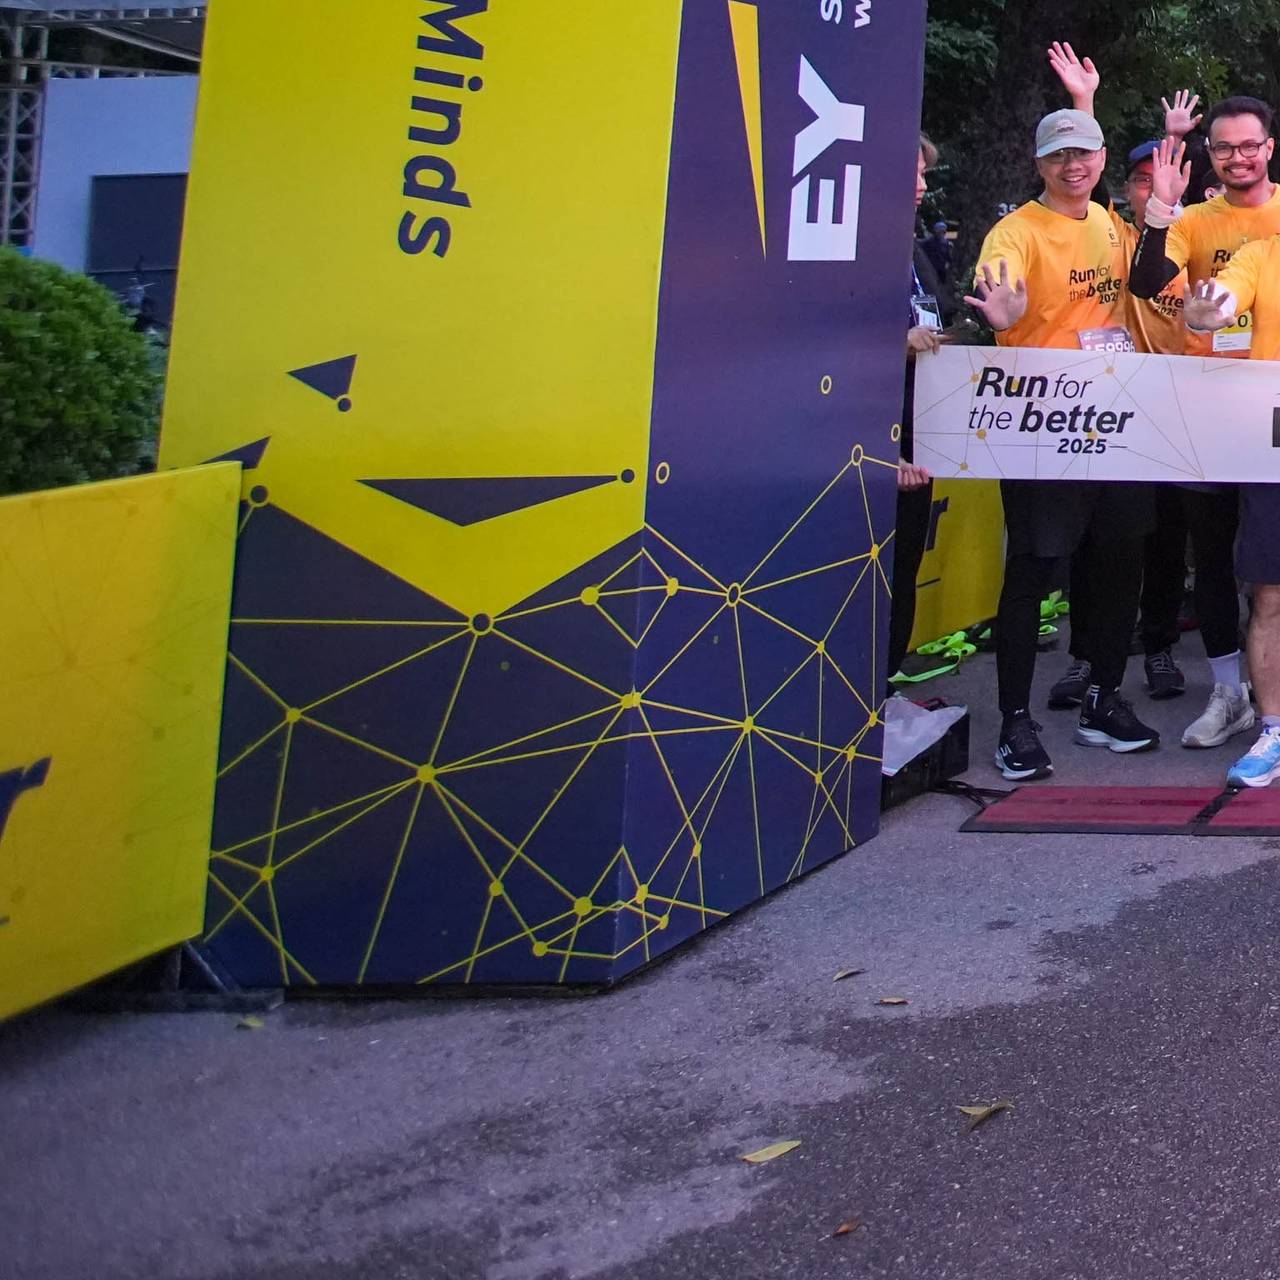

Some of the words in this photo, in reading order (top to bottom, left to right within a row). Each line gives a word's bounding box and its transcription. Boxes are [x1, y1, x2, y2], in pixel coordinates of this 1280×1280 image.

[787, 54, 866, 261] EY
[1213, 250, 1232, 263] Ru
[1069, 268, 1095, 285] Run
[1069, 289, 1086, 302] the
[1086, 277, 1122, 297] bette
[1153, 294, 1184, 307] ette
[975, 367, 1049, 398] Run
[1053, 373, 1092, 398] for
[968, 405, 1012, 429] the
[1019, 402, 1134, 434] better
[1057, 439, 1107, 455] 2025
